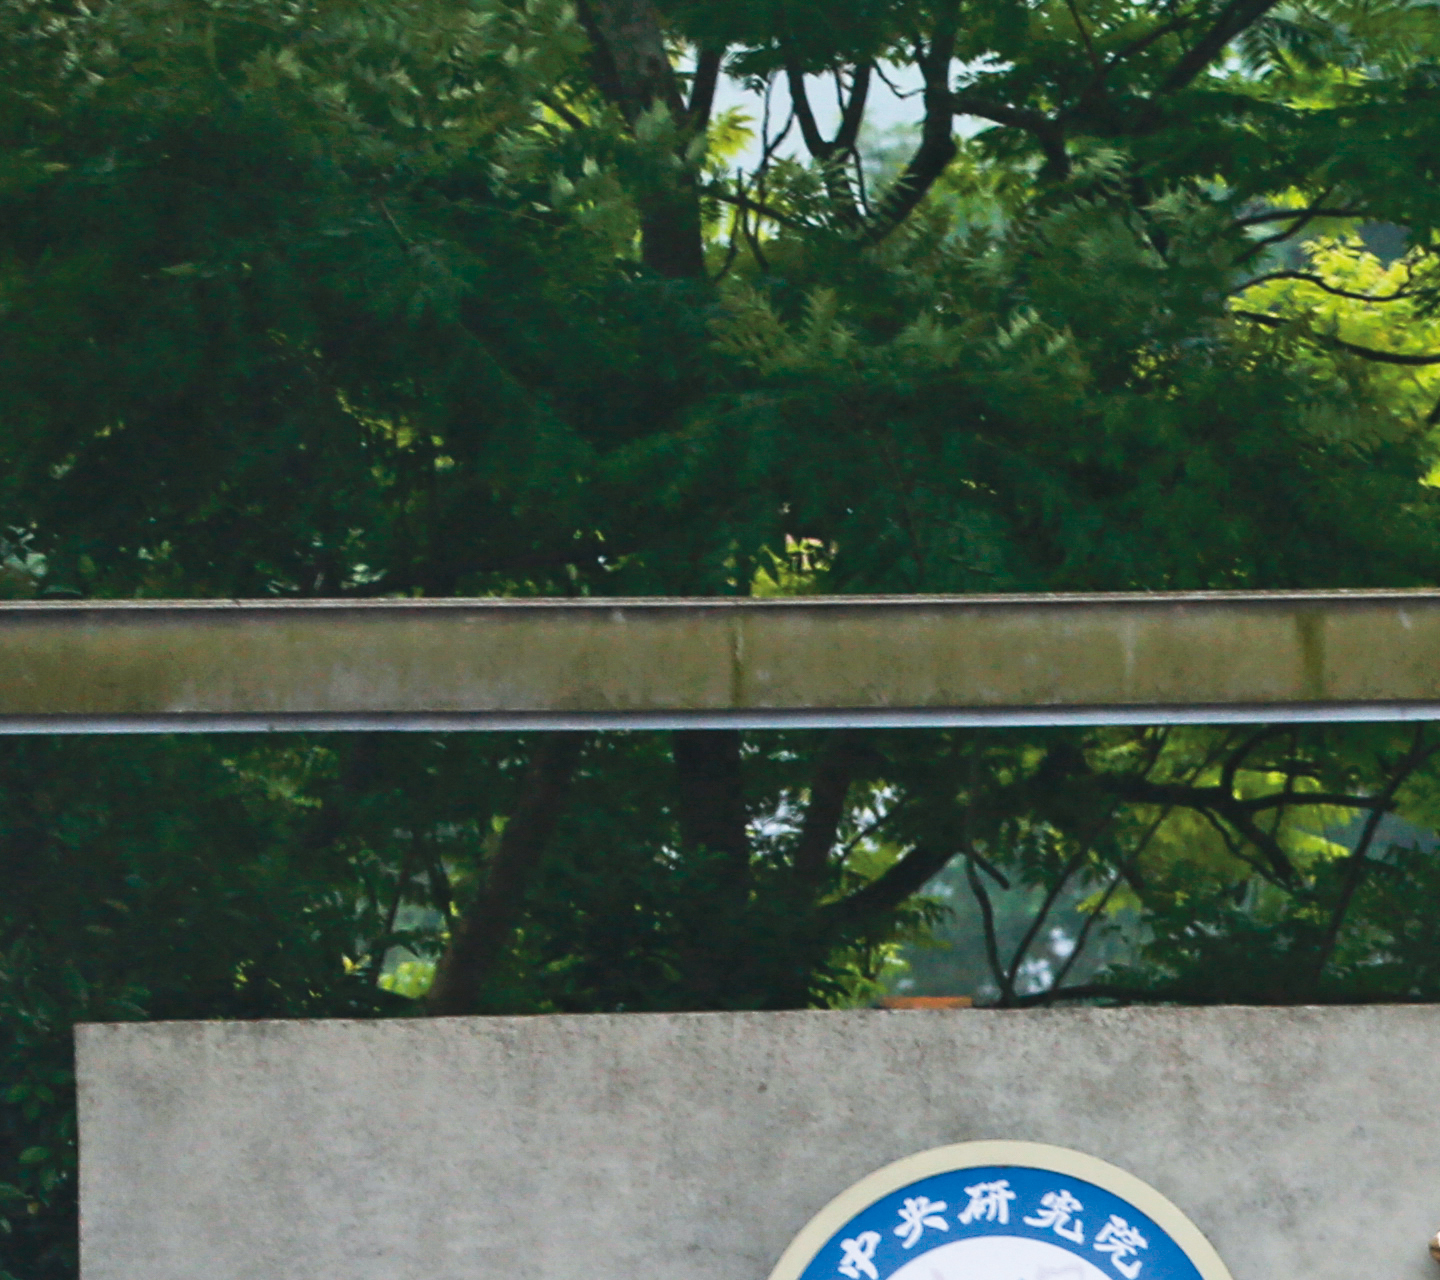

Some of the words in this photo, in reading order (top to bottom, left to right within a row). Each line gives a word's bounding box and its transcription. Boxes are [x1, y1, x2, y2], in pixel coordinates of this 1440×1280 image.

[837, 1180, 1149, 1280] 中央研究院
